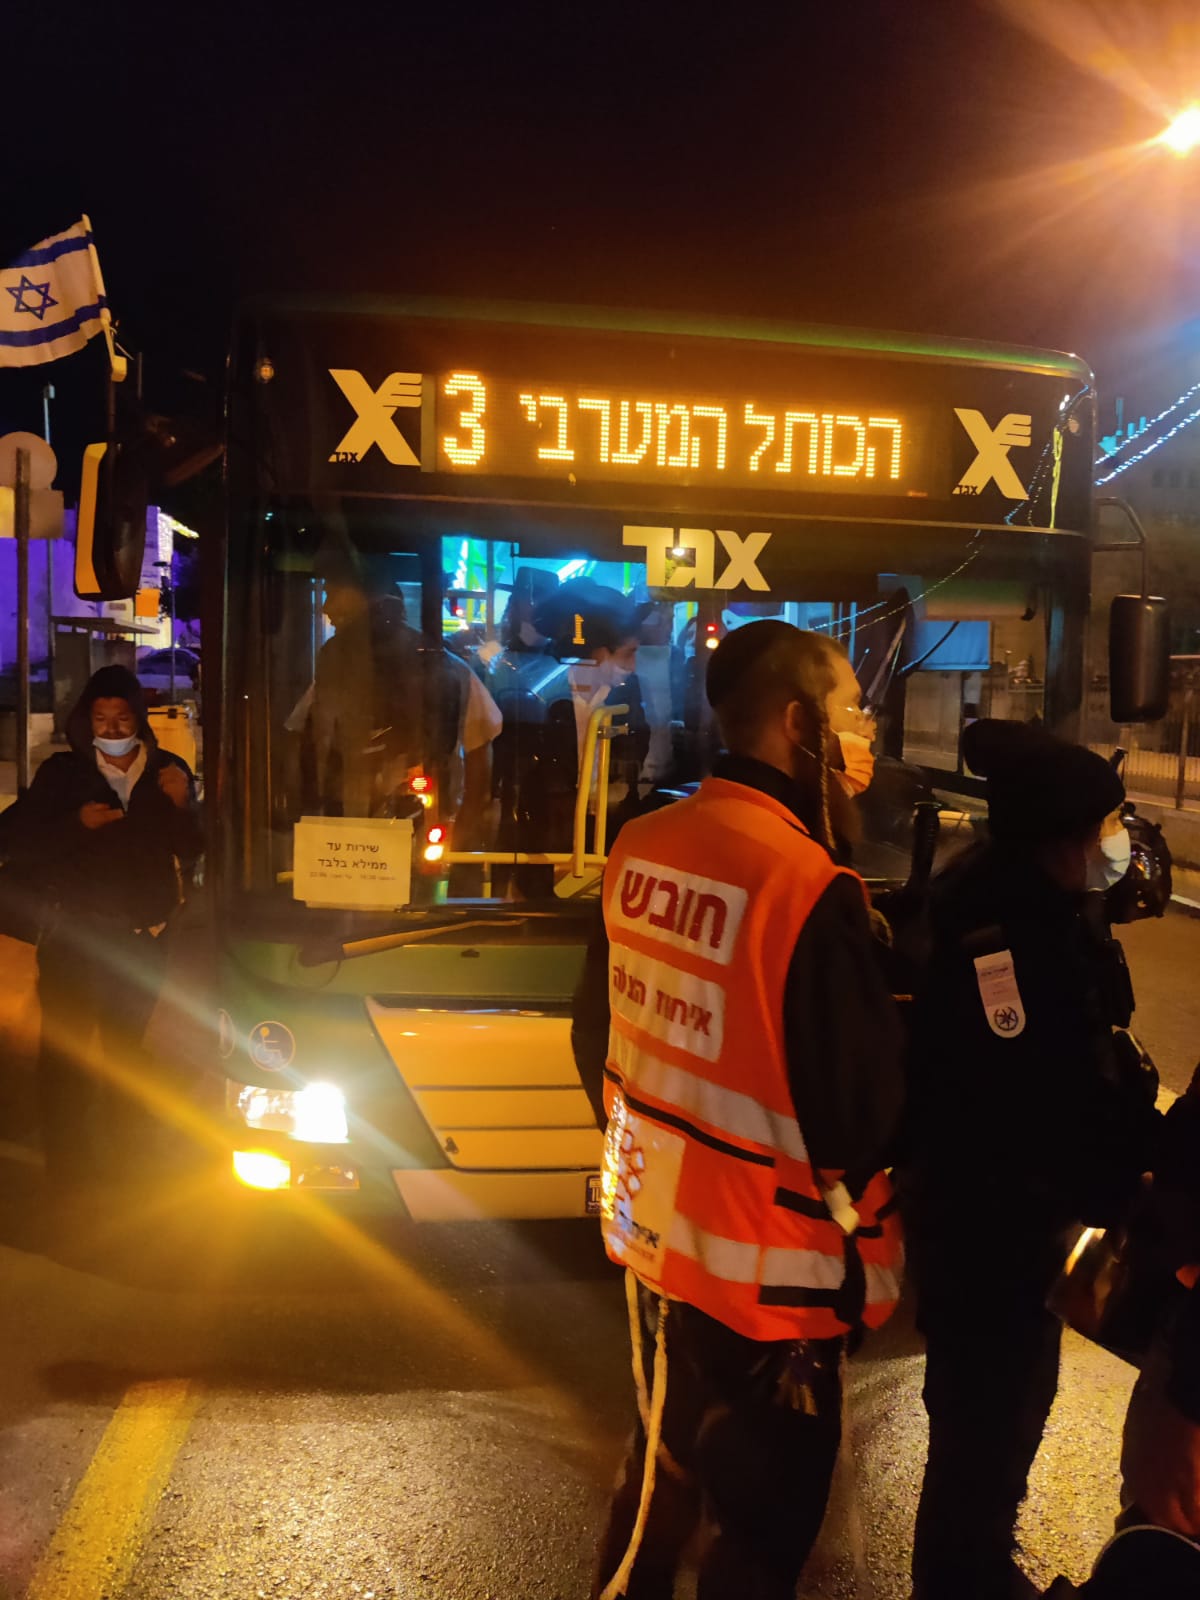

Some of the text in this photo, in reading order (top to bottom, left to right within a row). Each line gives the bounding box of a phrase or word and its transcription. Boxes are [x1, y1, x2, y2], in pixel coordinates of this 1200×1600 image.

[443, 373, 486, 466] 3
[519, 394, 902, 479] הכותל המערבי
[622, 525, 772, 592] אגד
[318, 856, 388, 870] ממילא בלבד
[327, 841, 380, 853] שירות עד
[620, 869, 728, 949] חובש
[656, 988, 713, 1037] איחוד
